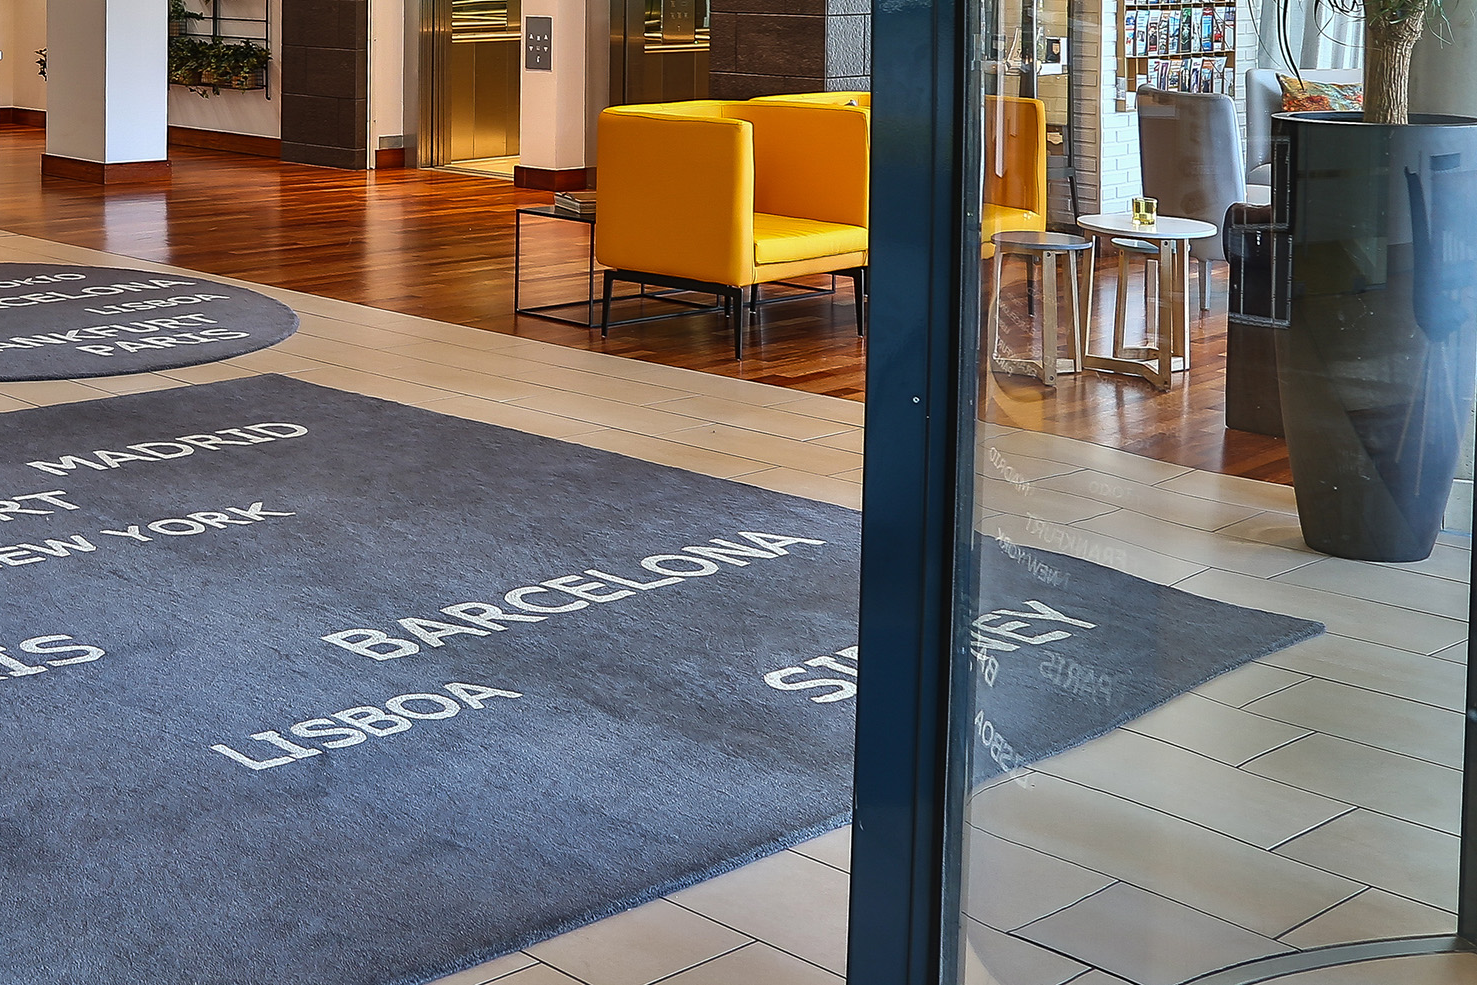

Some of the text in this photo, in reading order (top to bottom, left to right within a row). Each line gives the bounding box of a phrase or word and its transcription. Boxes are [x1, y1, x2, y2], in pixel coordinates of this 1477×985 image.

[84, 292, 231, 316] LISBOA
[75, 328, 250, 357] PARIS
[26, 421, 311, 478] MADRID
[99, 499, 297, 543] YORK
[321, 527, 827, 663] BARCELONA
[209, 681, 522, 771] LISBOA
